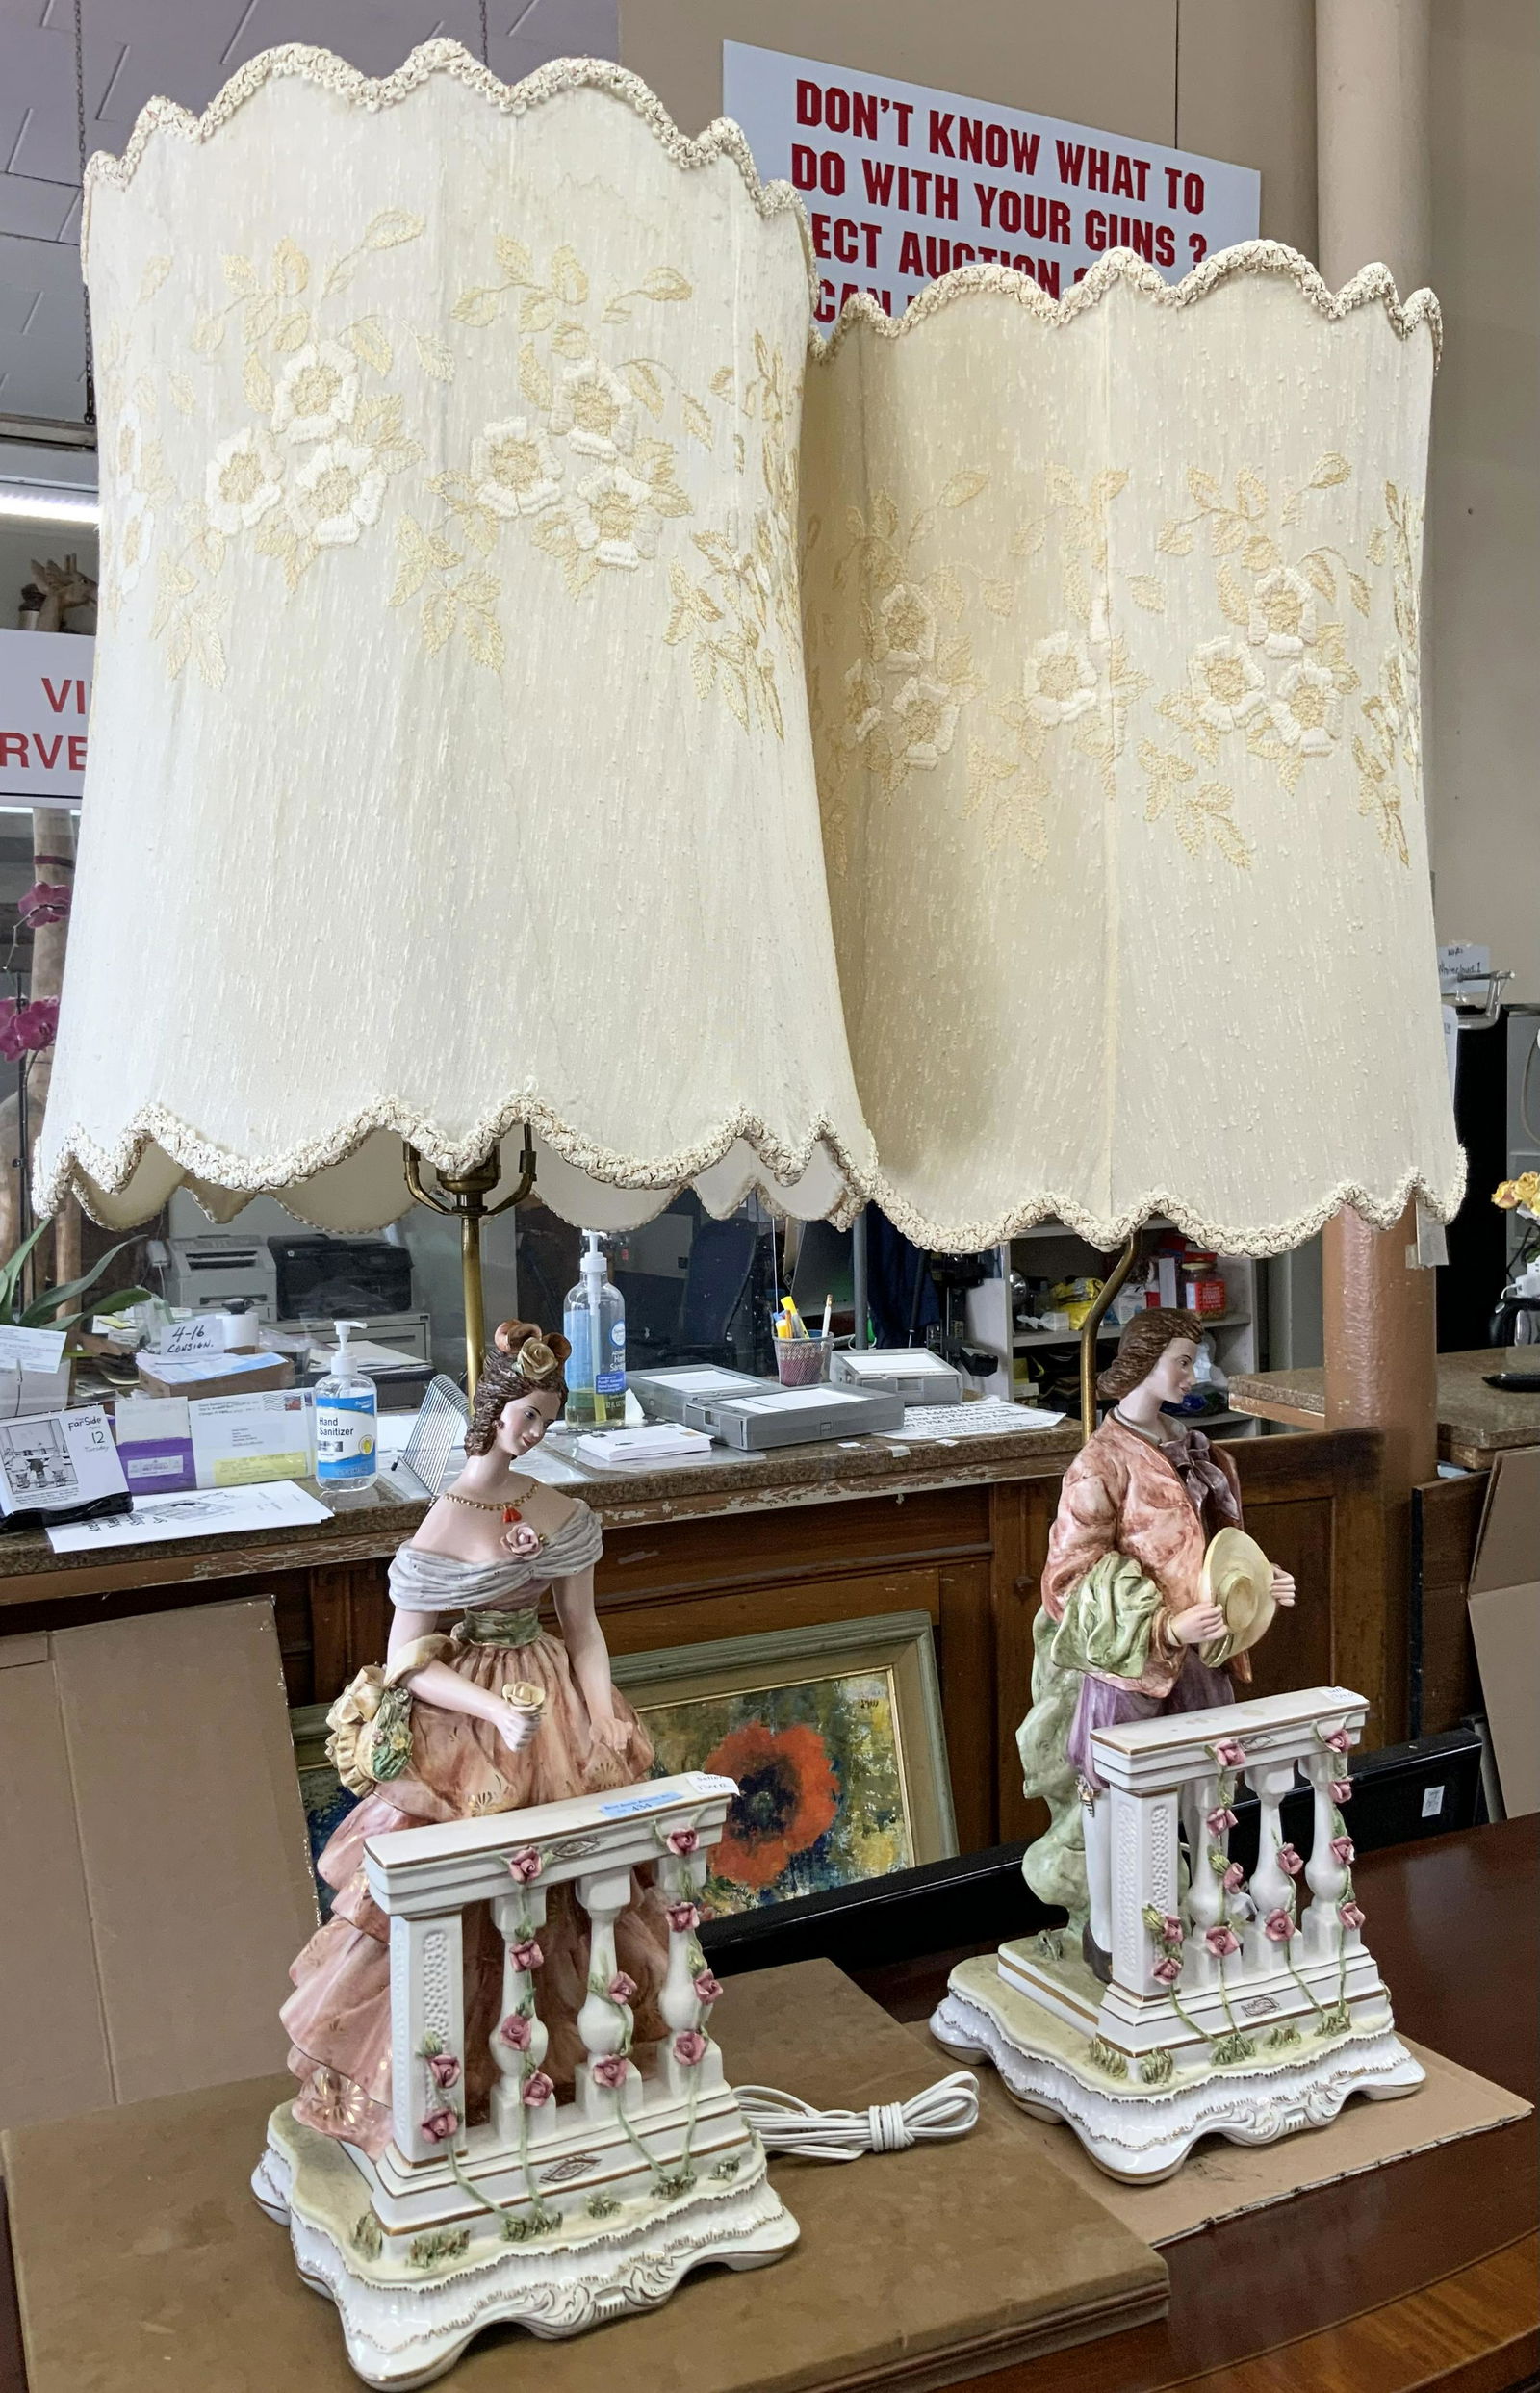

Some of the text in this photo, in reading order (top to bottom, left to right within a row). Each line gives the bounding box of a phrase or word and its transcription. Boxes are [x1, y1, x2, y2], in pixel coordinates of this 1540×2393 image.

[796, 78, 1204, 215] DON'T KNOW WHAT TO
[791, 143, 845, 197] DO
[862, 158, 959, 220] WITH
[974, 182, 1071, 245] YOUR
[1085, 209, 1175, 267] GUNS
[319, 1417, 339, 1426] Hand
[91, 1431, 106, 1444] 12
[319, 1427, 354, 1436] Sanitizer
